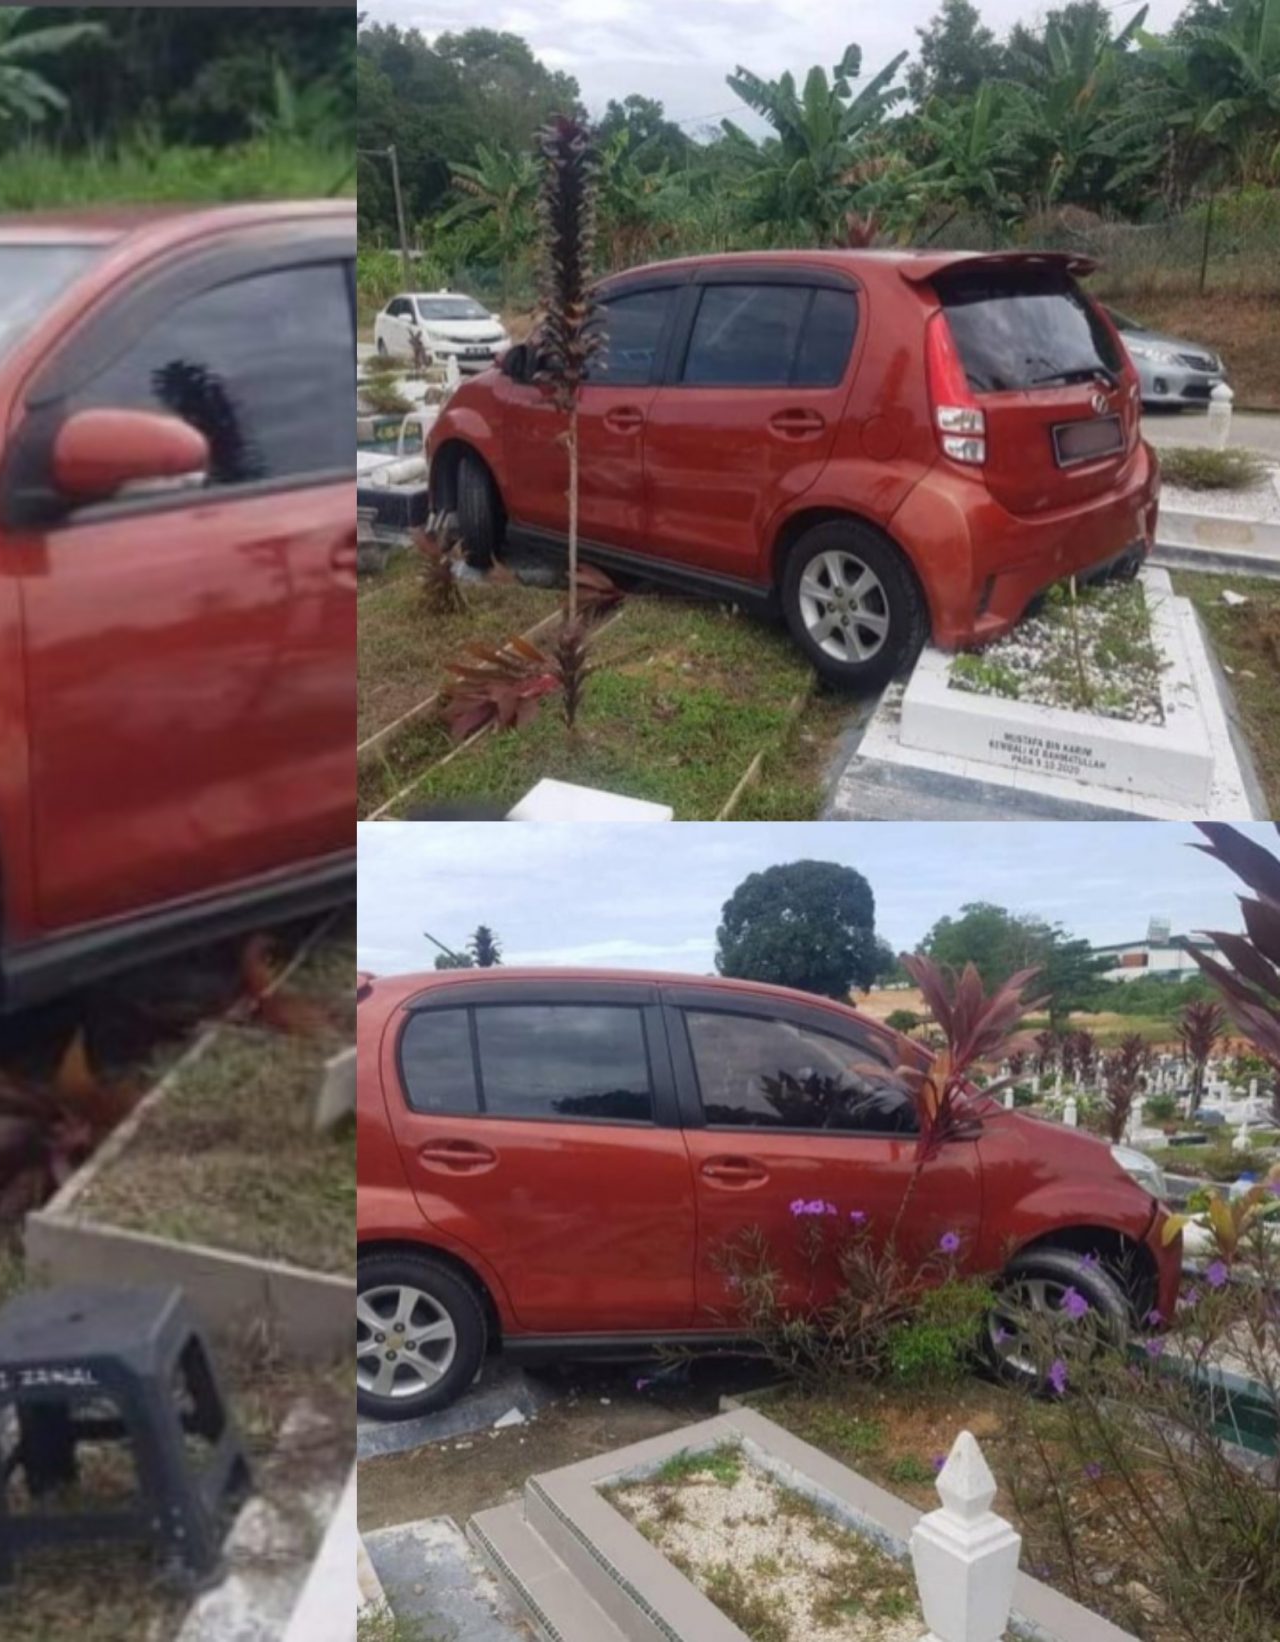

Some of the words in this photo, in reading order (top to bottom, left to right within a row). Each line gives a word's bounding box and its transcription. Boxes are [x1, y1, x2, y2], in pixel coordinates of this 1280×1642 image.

[989, 739, 1027, 754] KEMBALI
[1028, 747, 1039, 757] KE
[1042, 749, 1107, 769] RAHMATULLAH
[1045, 739, 1060, 751] BIN
[1011, 754, 1033, 765] PADA
[1057, 762, 1080, 775] 2020
